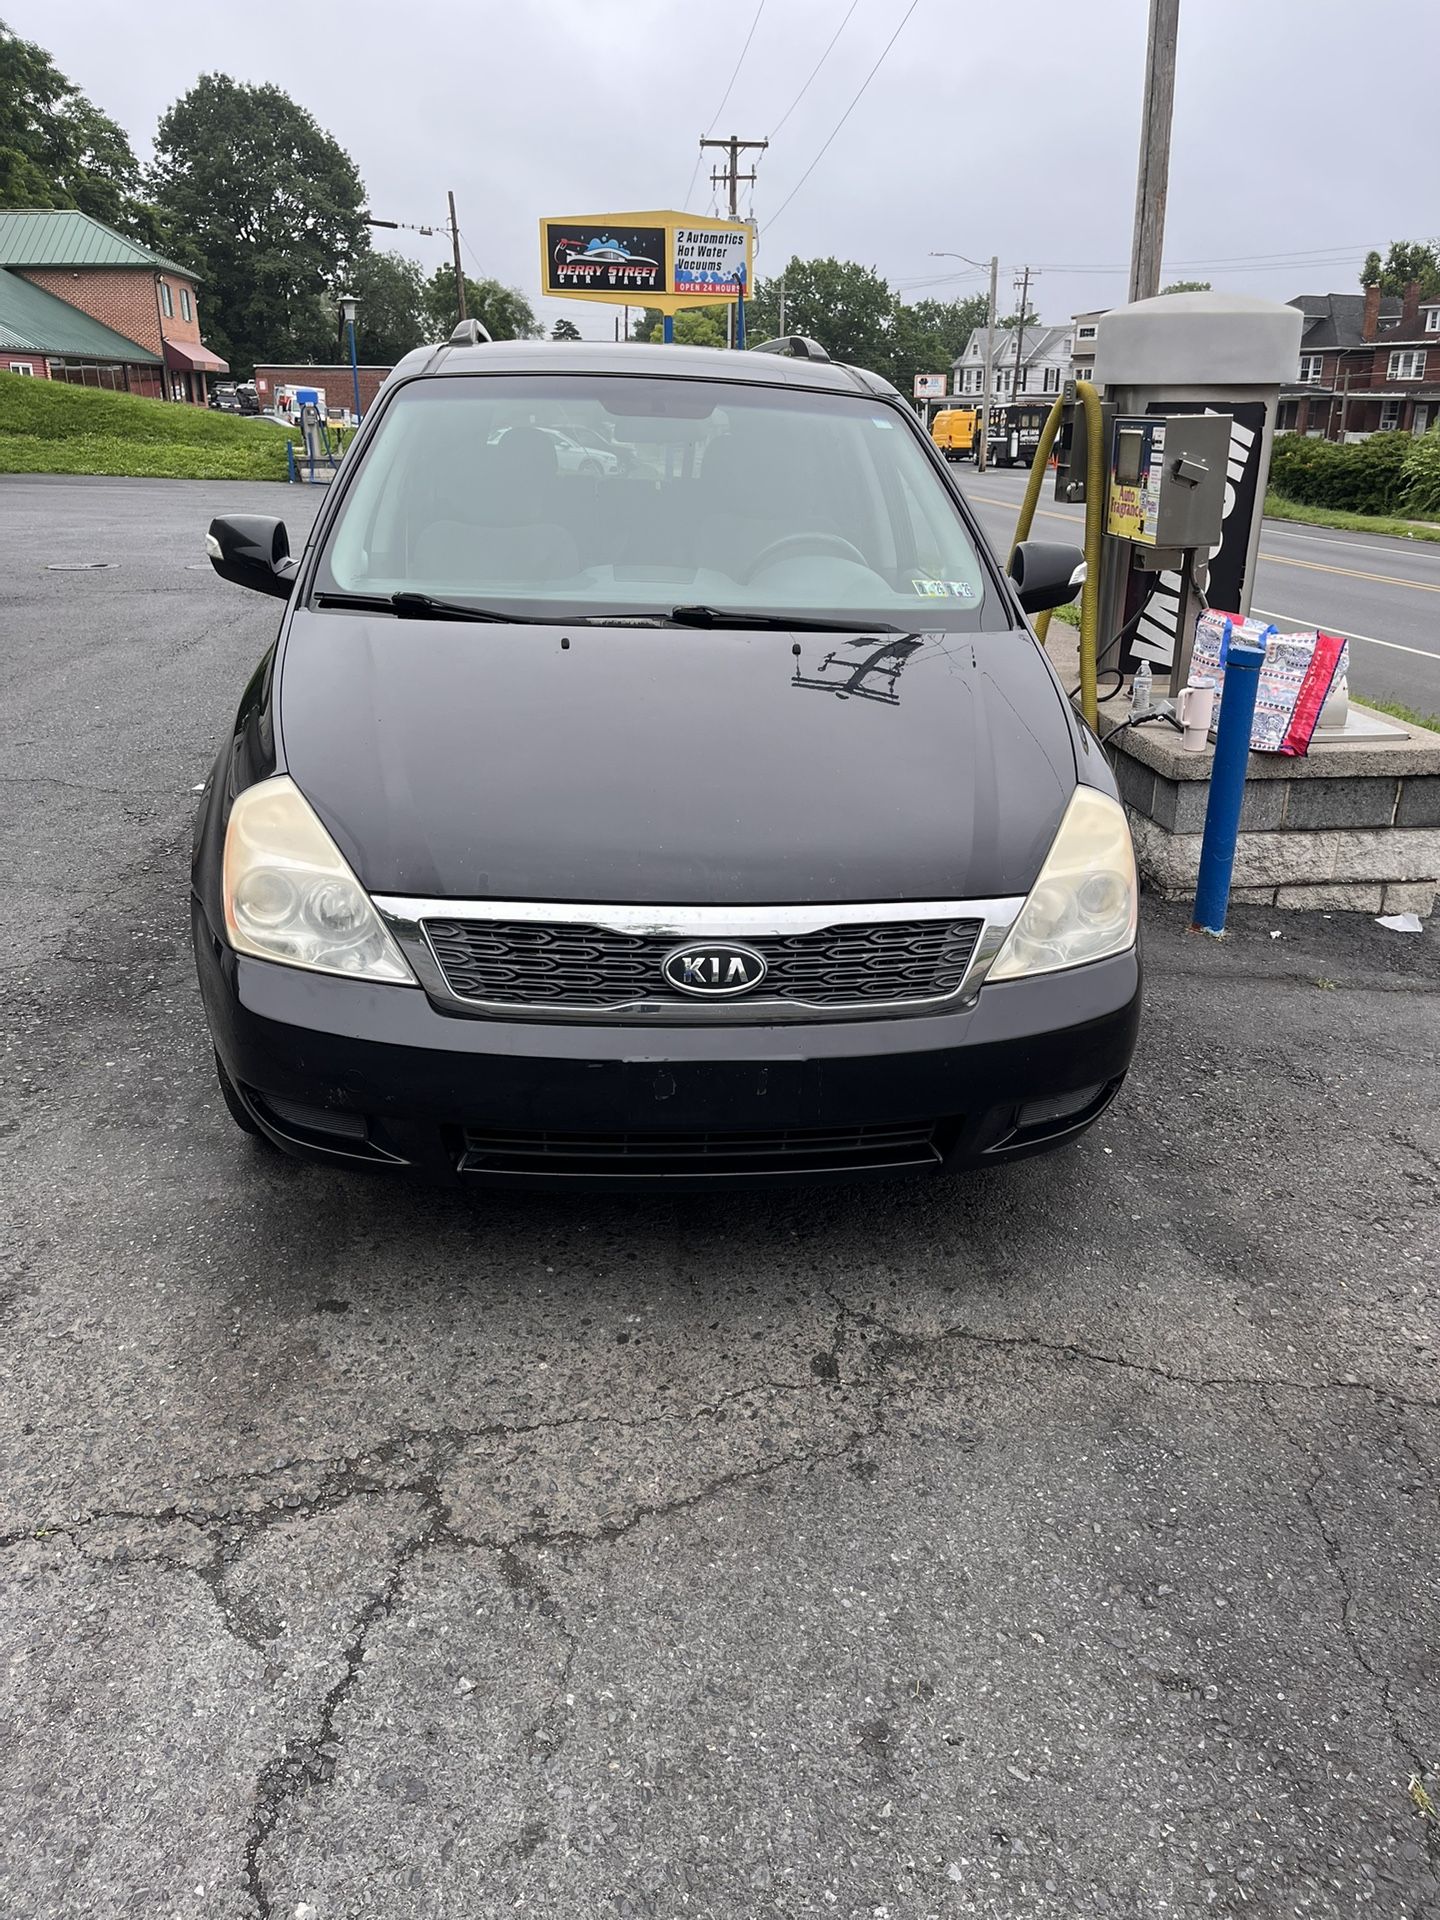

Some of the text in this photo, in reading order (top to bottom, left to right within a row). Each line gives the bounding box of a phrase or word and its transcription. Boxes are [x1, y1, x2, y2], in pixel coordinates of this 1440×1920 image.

[677, 231, 744, 245] 2 Automatics
[677, 245, 728, 258] Hot Water
[557, 264, 659, 277] DERRY STREET
[678, 258, 722, 271] Vacuums
[559, 275, 655, 285] CAR WASH
[679, 283, 740, 293] OPEN 24 HOURS
[1119, 485, 1136, 503] Auto
[1111, 497, 1143, 518] Fragrance
[682, 957, 749, 983] KIA
